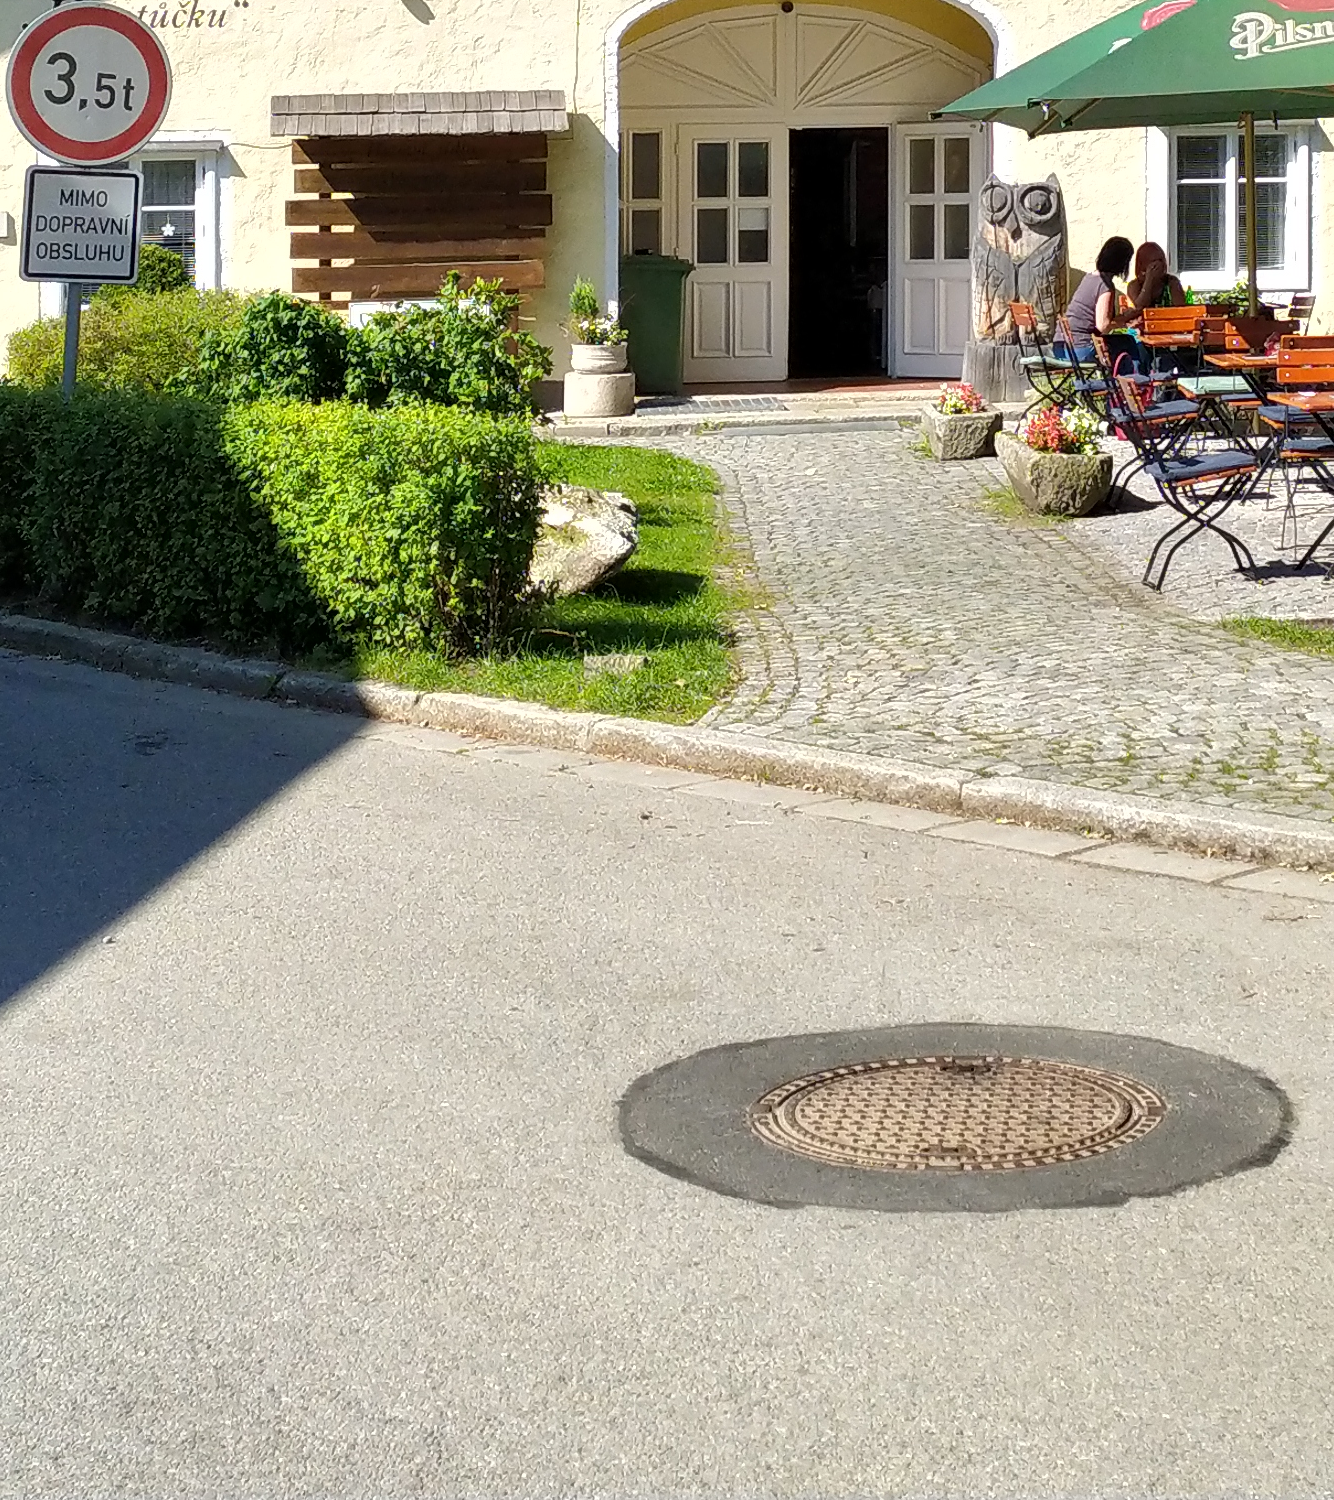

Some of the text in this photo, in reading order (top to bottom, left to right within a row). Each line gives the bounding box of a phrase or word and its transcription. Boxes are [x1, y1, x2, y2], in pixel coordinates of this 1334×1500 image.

[43, 51, 135, 112] 3,5t
[59, 188, 108, 208] MIMO
[35, 214, 130, 236] DOPRAVNÍ
[36, 241, 125, 262] OBSLUHU
